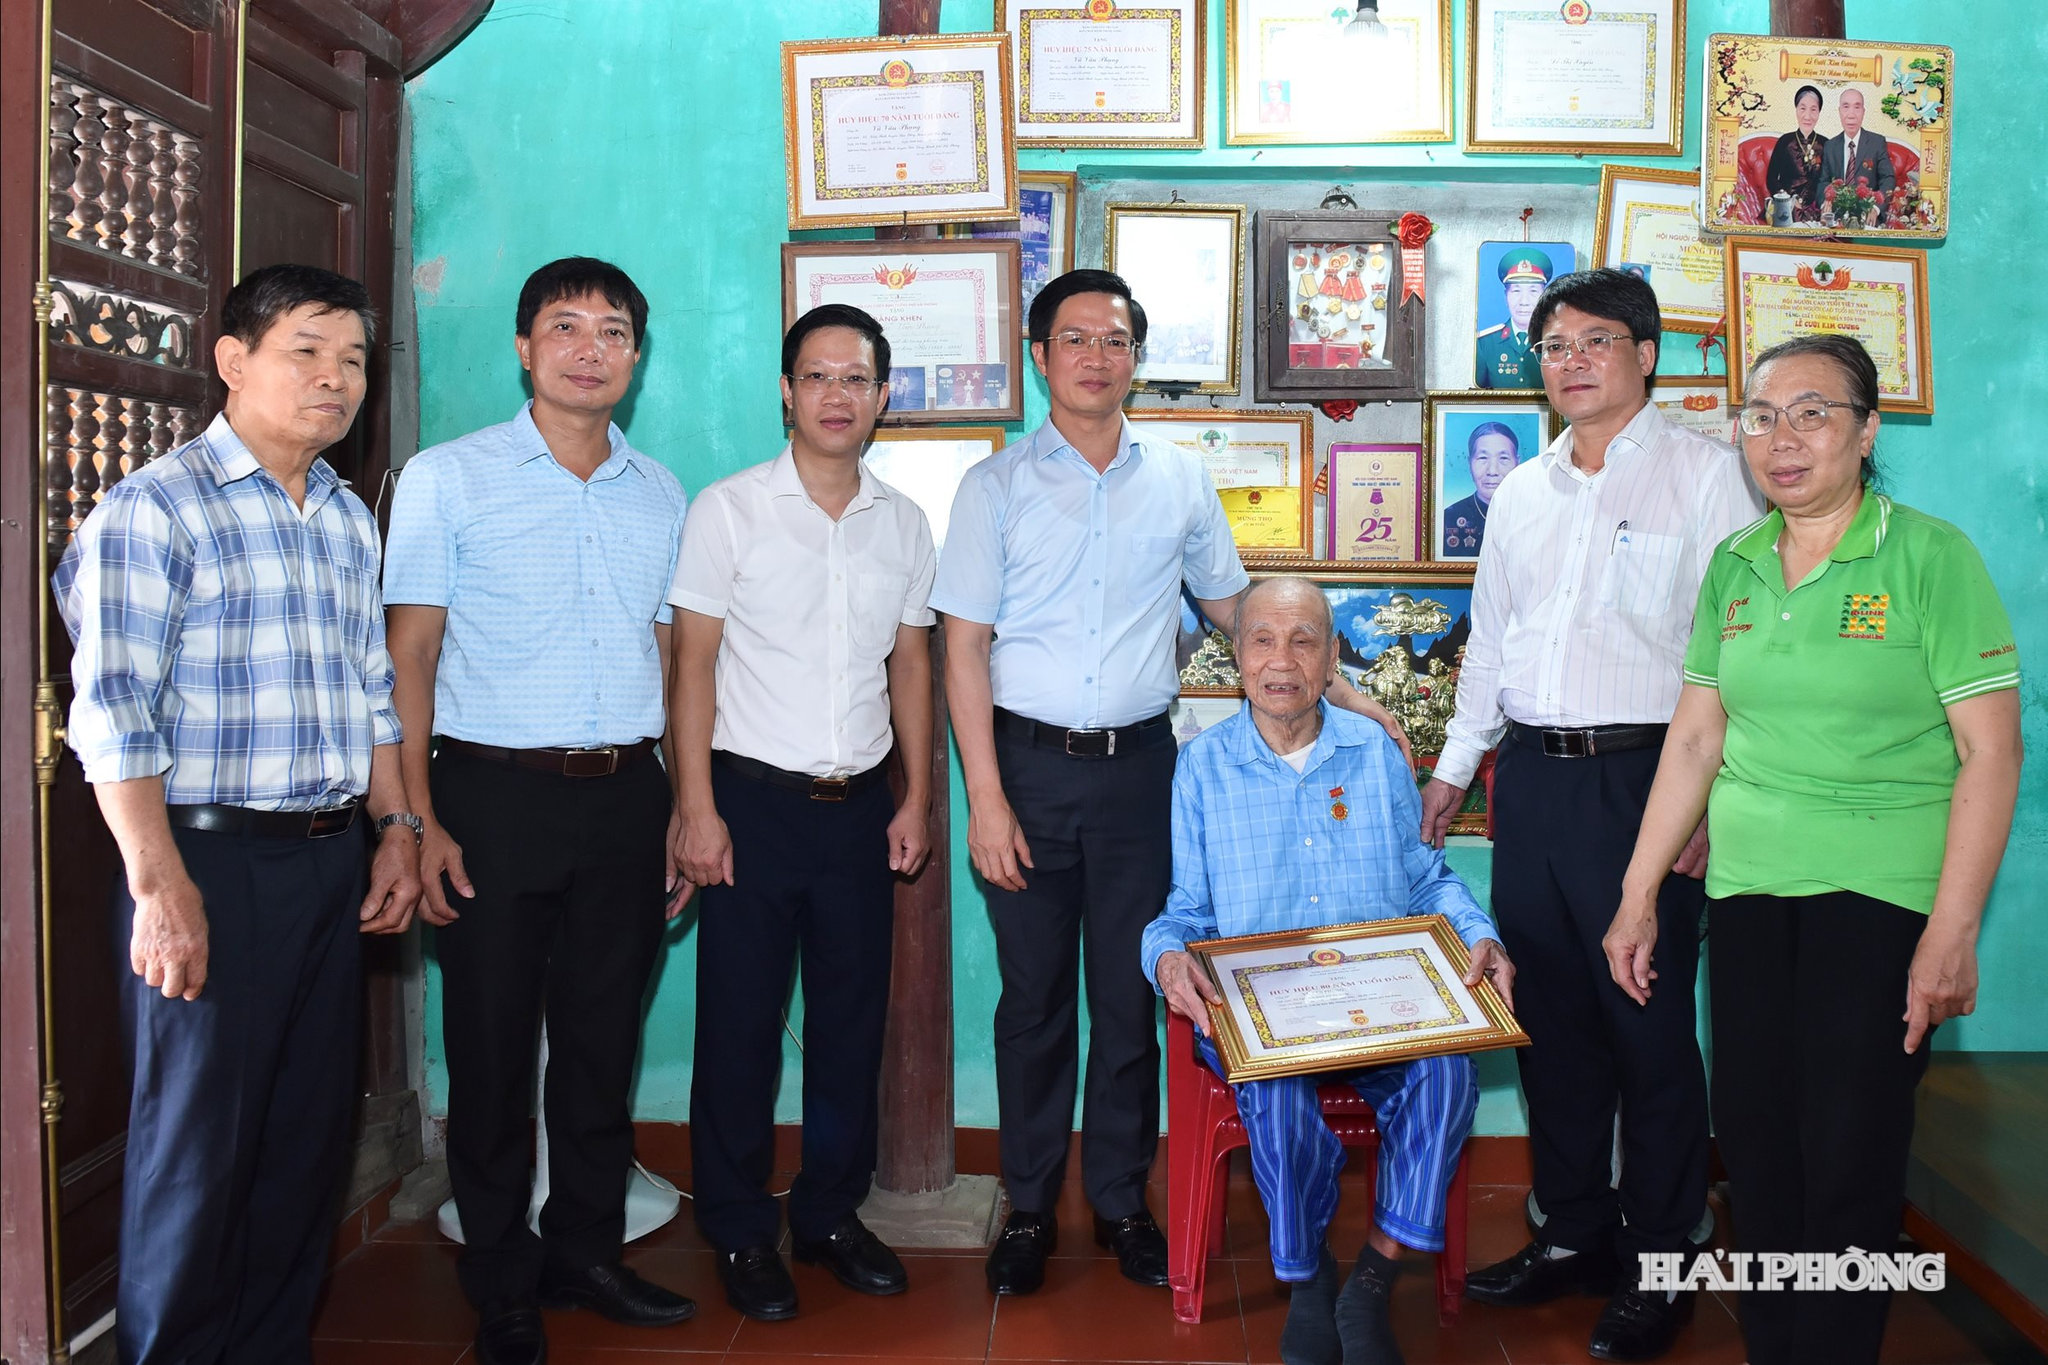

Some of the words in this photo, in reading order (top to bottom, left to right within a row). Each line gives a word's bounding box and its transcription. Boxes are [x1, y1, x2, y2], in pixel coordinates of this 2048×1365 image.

[1828, 59, 1840, 67] Kim
[838, 116, 855, 125] HUY
[858, 115, 878, 125] HIỆU
[1656, 231, 1668, 240] HỘI
[1668, 233, 1690, 243] NGƯỜI
[899, 314, 923, 323] KHEN
[1822, 321, 1836, 330] KIM
[1213, 467, 1229, 475] TUỔI
[1229, 467, 1243, 477] VIỆT
[1218, 477, 1235, 488] THỌ
[1236, 514, 1257, 523] MỪNG
[1355, 516, 1394, 543] 25
[1269, 987, 1290, 997] HUY
[1293, 984, 1318, 994] HIỆU
[1333, 979, 1356, 989] NĂM
[1358, 976, 1382, 987] TUỔI
[1383, 974, 1413, 984] ĐẢNG
